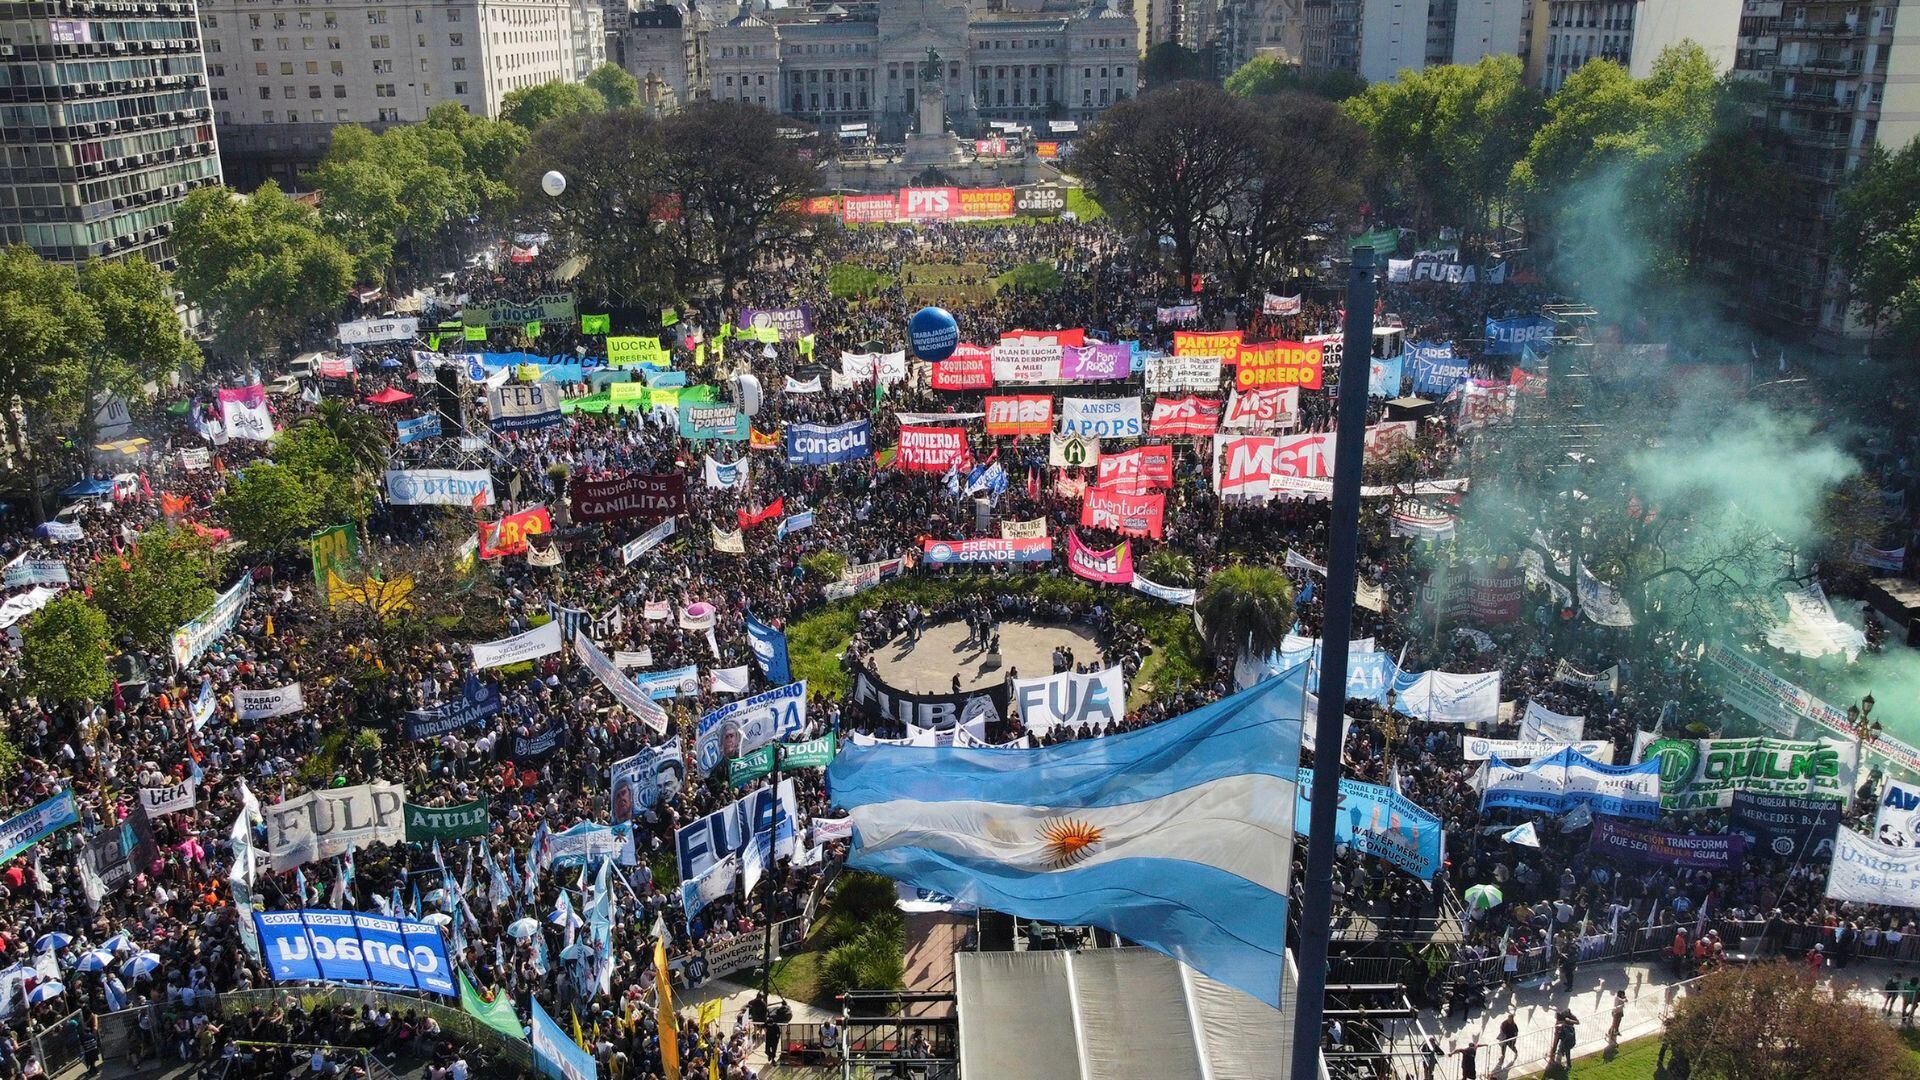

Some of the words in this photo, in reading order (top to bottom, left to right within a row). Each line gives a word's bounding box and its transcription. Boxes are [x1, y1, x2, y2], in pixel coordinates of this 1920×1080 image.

[907, 190, 949, 212] PTS
[961, 193, 1011, 203] PARTIDO
[1025, 190, 1057, 199] POLO
[846, 201, 892, 210] IZQUIERDA
[963, 203, 1010, 213] OBRERO
[1018, 199, 1064, 209] OBRERO
[846, 210, 893, 219] SOCIALISTA
[1415, 262, 1476, 283] FUBA
[502, 308, 546, 321] UOCRA
[771, 310, 804, 320] UOCRA
[367, 324, 395, 335] AEFIP
[1498, 325, 1555, 343] LIBRES
[611, 341, 656, 351] UOCRA
[1176, 335, 1240, 348] PARTIDO
[614, 353, 658, 363] PRESENTE
[998, 348, 1019, 356] PLAN
[1031, 348, 1057, 356] LUCHA
[1240, 348, 1321, 367] PARTIDO
[939, 360, 984, 371] IZQUIERDA
[938, 373, 986, 384] SOCIALISTA
[1239, 367, 1314, 385] OBRERO
[1428, 375, 1448, 386] DEL
[500, 387, 543, 407] FEB
[1240, 392, 1289, 418] MST
[994, 400, 1051, 423] mas
[1081, 403, 1121, 414] ANSES
[1152, 402, 1197, 421] PTS
[506, 418, 540, 428] Educación
[540, 414, 562, 423] Pública
[694, 417, 736, 431] POPULAR
[1064, 418, 1139, 437] APOPS
[794, 430, 867, 454] conadu
[901, 433, 961, 449] IZQUIERDA
[1228, 440, 1334, 481] MST
[423, 478, 491, 496] UTEDYC
[587, 478, 648, 497] SINDICATO
[650, 482, 668, 492] DE
[580, 494, 677, 515] CANILLITAS
[1087, 487, 1146, 515] Juventud
[1092, 509, 1120, 531] PTS
[959, 550, 1016, 560] GRANDE
[1022, 542, 1046, 558] Pilar
[961, 540, 1014, 551] FRENTE
[1073, 548, 1118, 574] AUGE
[243, 695, 281, 704] TRABAJO
[746, 682, 803, 706] ROMERO
[1018, 677, 1113, 723] FUA
[243, 703, 273, 711] SOCIAL
[437, 697, 471, 719] ATSA
[413, 704, 483, 737] HURLINGHAM
[699, 703, 738, 735] SERGIO
[1704, 751, 1839, 781] QUILMS
[1373, 787, 1384, 796] DE
[1602, 779, 1651, 793] MIGUEL
[1344, 788, 1375, 801] LOMAS
[1377, 795, 1388, 805] DE
[1389, 800, 1418, 823] ZAMORA
[1602, 801, 1660, 816] GENERAL
[1757, 796, 1787, 808] OBRERA
[273, 791, 401, 848] FULP
[410, 807, 486, 829] ATULP
[1741, 808, 1795, 824] MERCEDES
[8, 822, 43, 849] JODE
[1603, 824, 1613, 833] LA
[1666, 837, 1729, 850] TRANSFORMA
[1351, 825, 1394, 848] WALTER
[1395, 844, 1430, 866] MERKIS
[1602, 833, 1609, 843] Y
[1609, 835, 1627, 847] QUE
[1629, 839, 1648, 851] SEA
[1693, 850, 1729, 861] IGUALA
[1358, 839, 1422, 874] CONDUCCION
